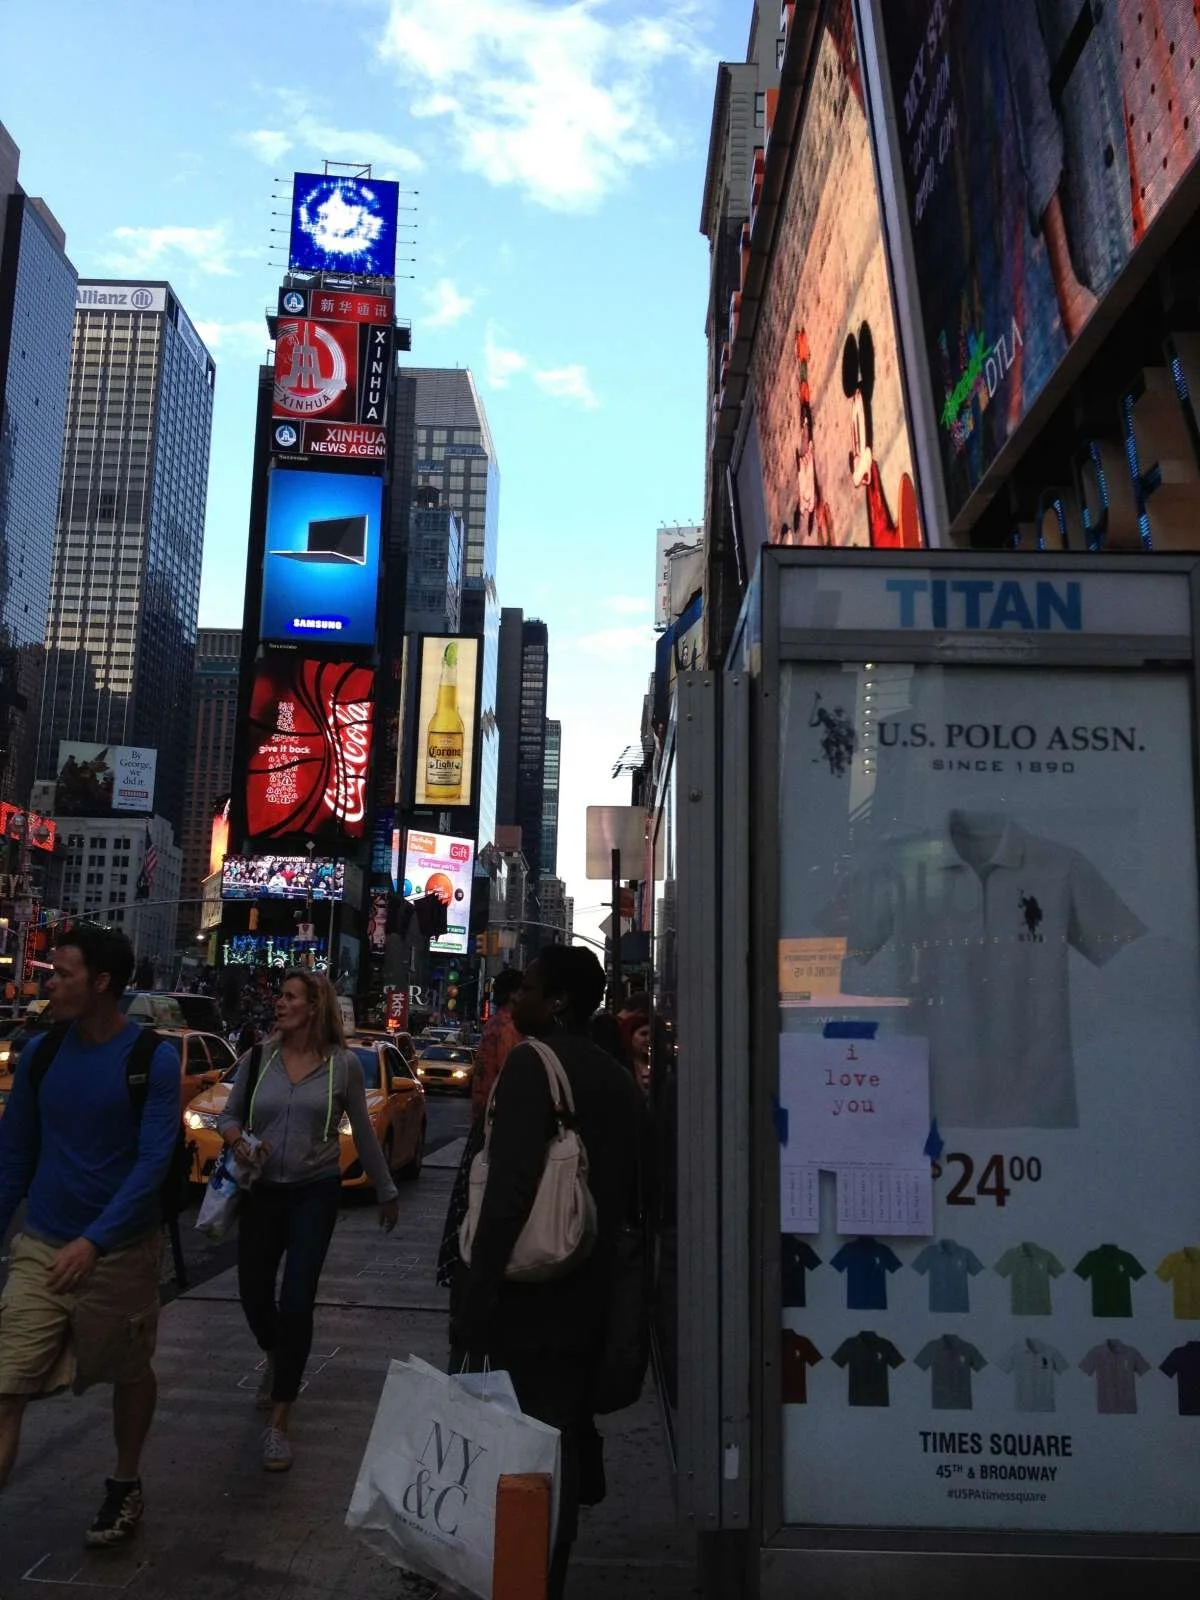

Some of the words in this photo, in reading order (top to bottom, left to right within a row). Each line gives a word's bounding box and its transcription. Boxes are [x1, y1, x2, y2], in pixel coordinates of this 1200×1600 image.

[367, 331, 386, 419] XINHUA
[280, 394, 331, 410] XINHUA
[326, 428, 385, 444] XINHUA
[311, 441, 346, 454] NEWS
[349, 444, 385, 456] AGEN
[886, 579, 1082, 631] TITAN
[293, 618, 342, 630] SAMSUNG
[877, 722, 935, 748] U.S.
[946, 724, 1037, 750] POLO
[1046, 726, 1146, 752] ASSN.
[132, 751, 144, 761] By
[258, 744, 278, 754] give
[280, 744, 287, 753] it
[289, 745, 312, 755] back
[932, 760, 1004, 772] SINCE
[1017, 761, 1075, 774] 1890
[123, 775, 136, 785] did
[451, 846, 468, 859] Gift
[391, 992, 404, 1018] tkts
[846, 1043, 859, 1061] i
[825, 1069, 880, 1088] love
[832, 1099, 875, 1116] you
[919, 1431, 982, 1455] TIMES
[990, 1433, 1072, 1457] SQUARE
[416, 1419, 488, 1487] NY
[967, 1467, 976, 1479] &
[980, 1465, 1058, 1482] BROADWAY
